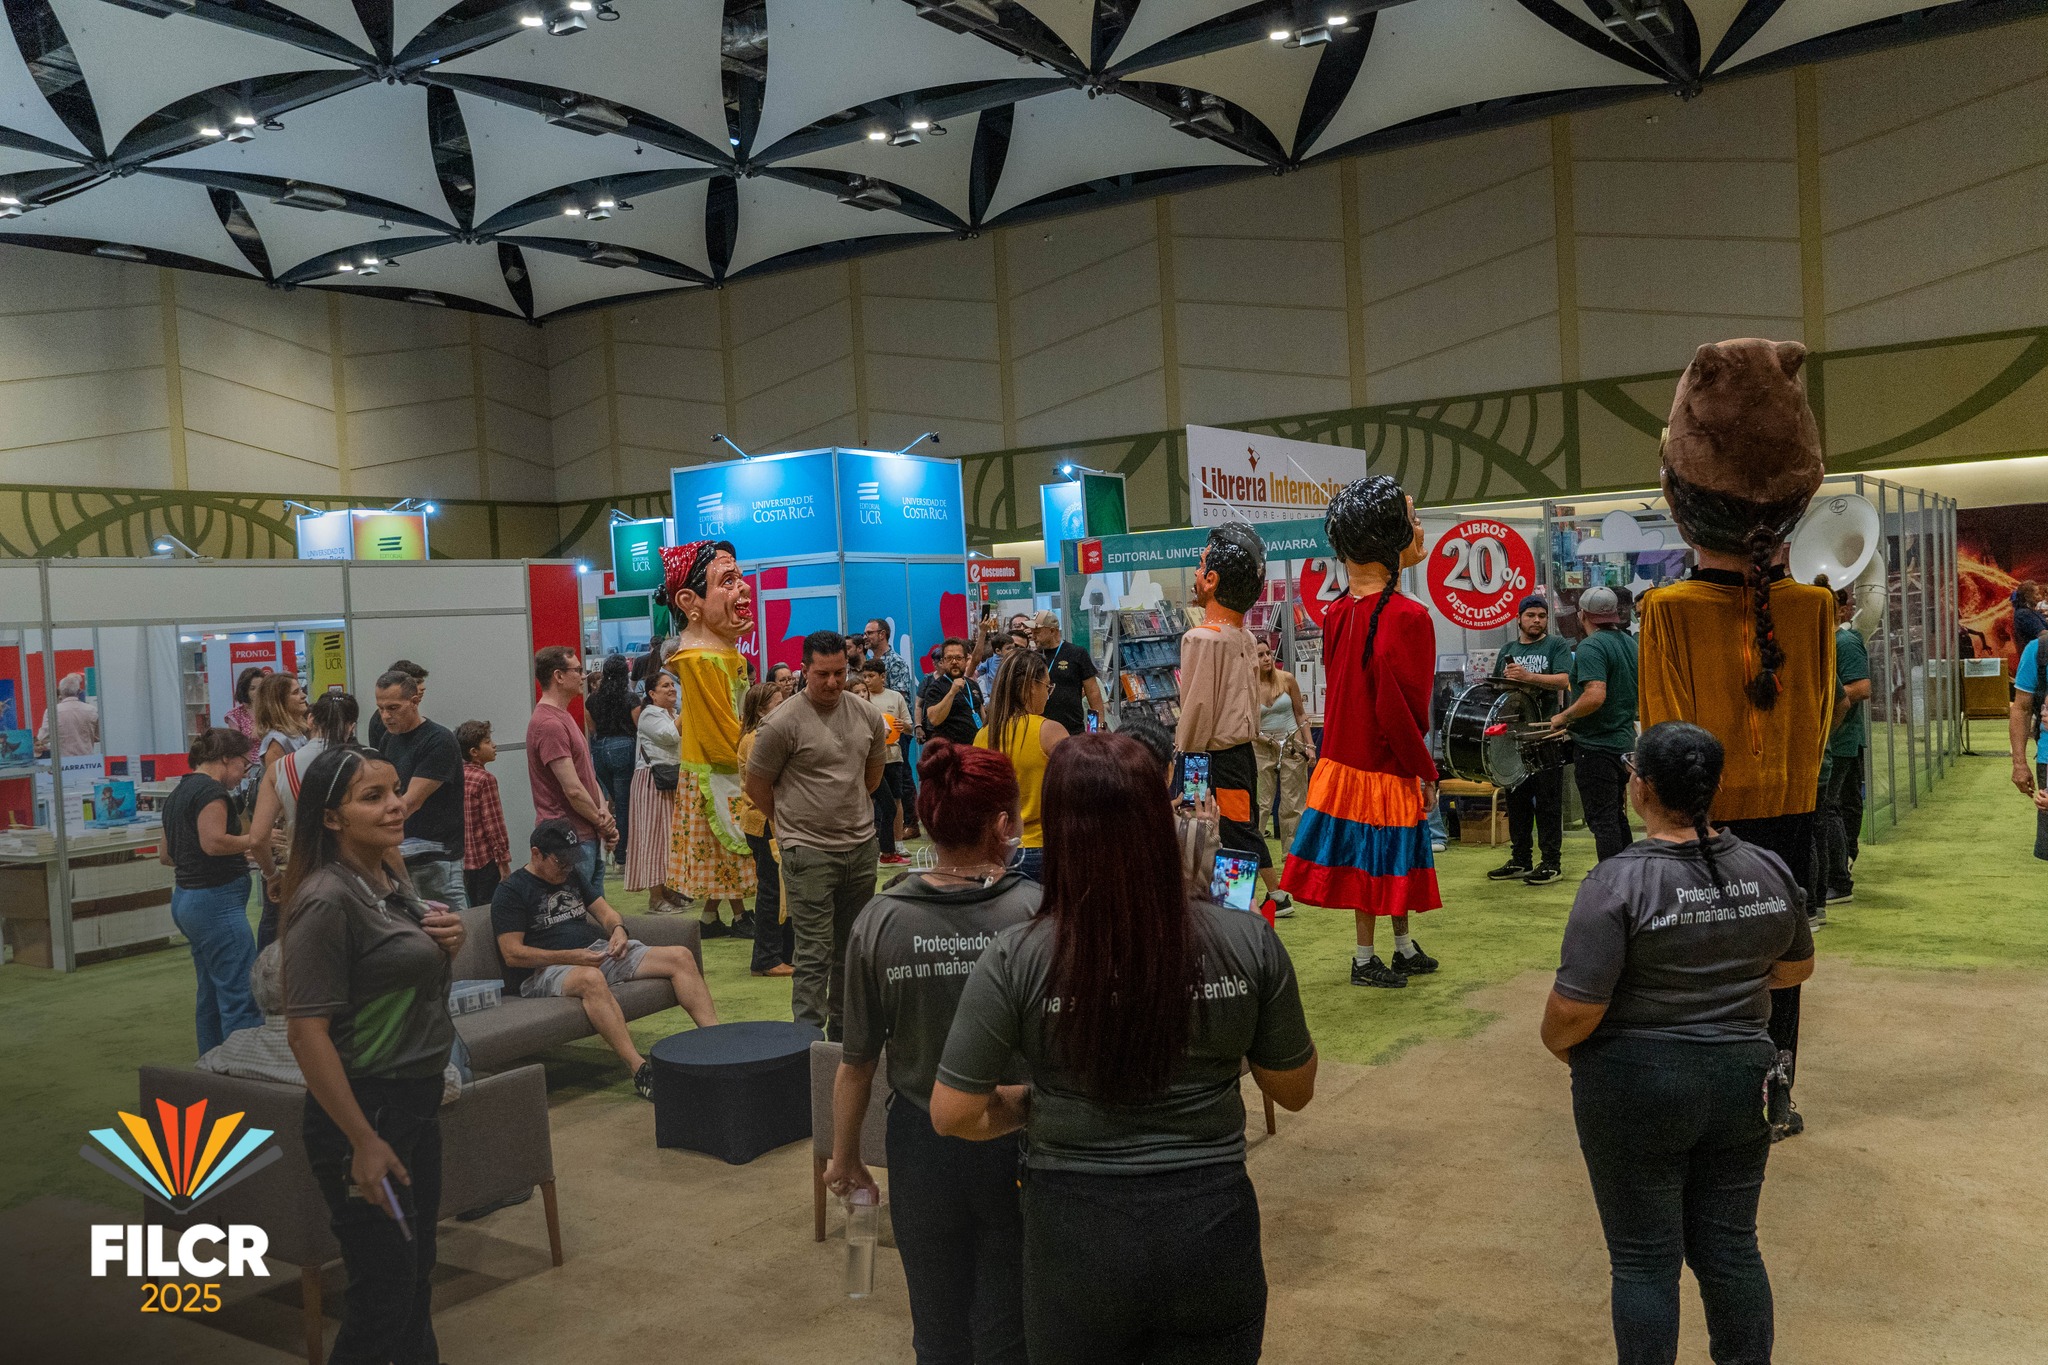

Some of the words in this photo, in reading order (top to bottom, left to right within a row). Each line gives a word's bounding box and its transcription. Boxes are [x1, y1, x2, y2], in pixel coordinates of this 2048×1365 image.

[1270, 471, 1345, 505] Internacio
[752, 497, 803, 510] UNIVERSIDAD
[803, 495, 814, 503] DE
[902, 497, 939, 507] UNIVERSIDAD
[939, 499, 947, 507] DE
[753, 509, 788, 523] COSTA
[789, 506, 815, 519] RICA
[860, 510, 882, 525] UCR
[903, 505, 929, 519] COSTA
[929, 507, 948, 520] RICA
[699, 522, 726, 537] UCR
[1460, 522, 1508, 539] LIBROS
[1265, 538, 1317, 552] NAVARRA
[1108, 551, 1164, 564] EDITORIAL
[632, 561, 651, 572] UCR
[1446, 591, 1514, 619] DESCUENTO
[325, 658, 343, 670] UCR
[1676, 881, 1740, 904] Protegiedo
[1740, 879, 1760, 898] hoy
[1652, 913, 1678, 930] para
[1680, 912, 1693, 924] un
[1695, 905, 1737, 923] mañana
[1739, 896, 1787, 918] sostenible
[913, 932, 991, 956] Protegiendo
[886, 965, 913, 985] para
[915, 962, 931, 978] un
[934, 956, 976, 976] mañan
